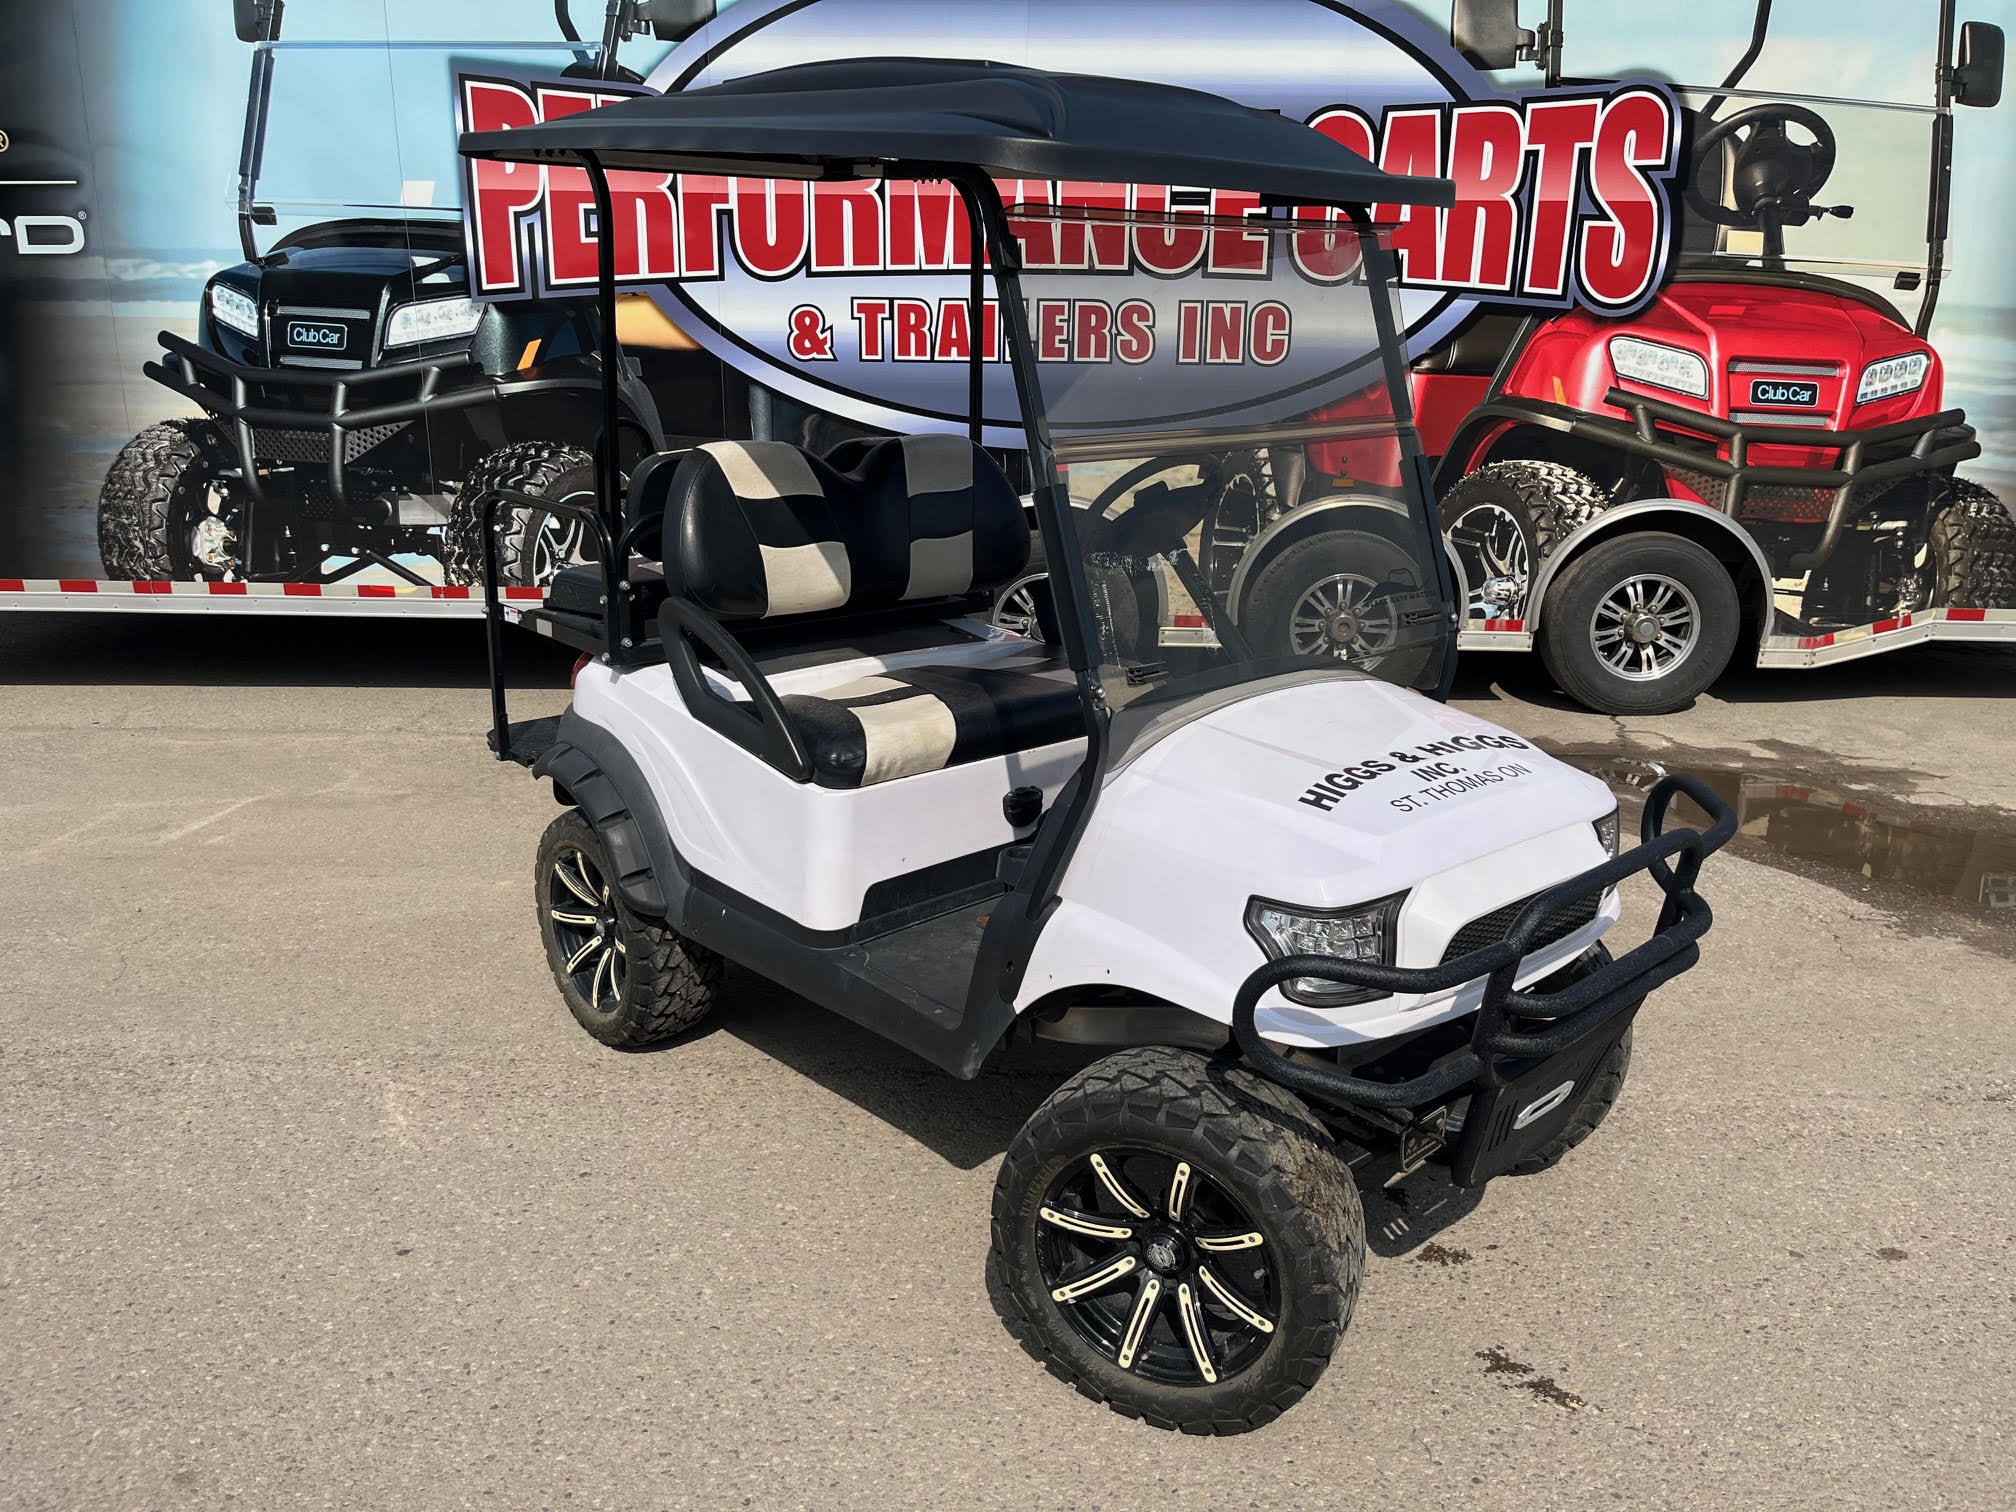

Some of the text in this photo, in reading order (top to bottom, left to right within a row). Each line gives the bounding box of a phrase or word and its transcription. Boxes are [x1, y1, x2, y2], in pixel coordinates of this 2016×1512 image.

[294, 327, 340, 344] Club Car
[789, 305, 838, 362] &
[1177, 300, 1292, 366] INC
[1757, 385, 1812, 401] Club Car
[1298, 734, 1530, 812] HIGGS & HIGGS
[1390, 763, 1532, 813] ST. THOMAS ON
[1409, 762, 1467, 782] INC.
